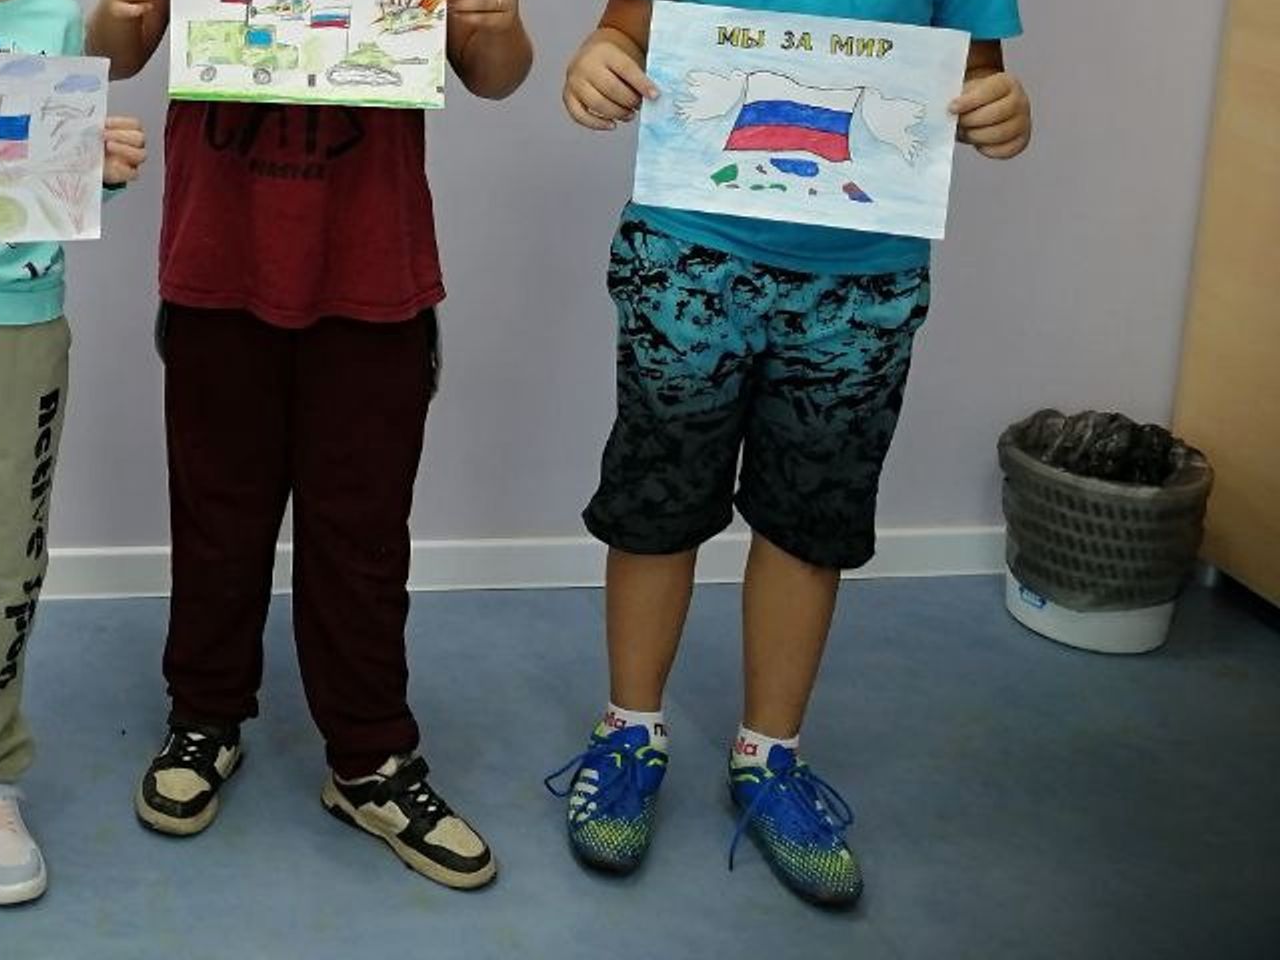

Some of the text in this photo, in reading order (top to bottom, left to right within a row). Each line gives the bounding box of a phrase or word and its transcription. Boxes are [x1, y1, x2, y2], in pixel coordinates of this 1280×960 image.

[717, 26, 894, 58] МЫ ЗА МИР
